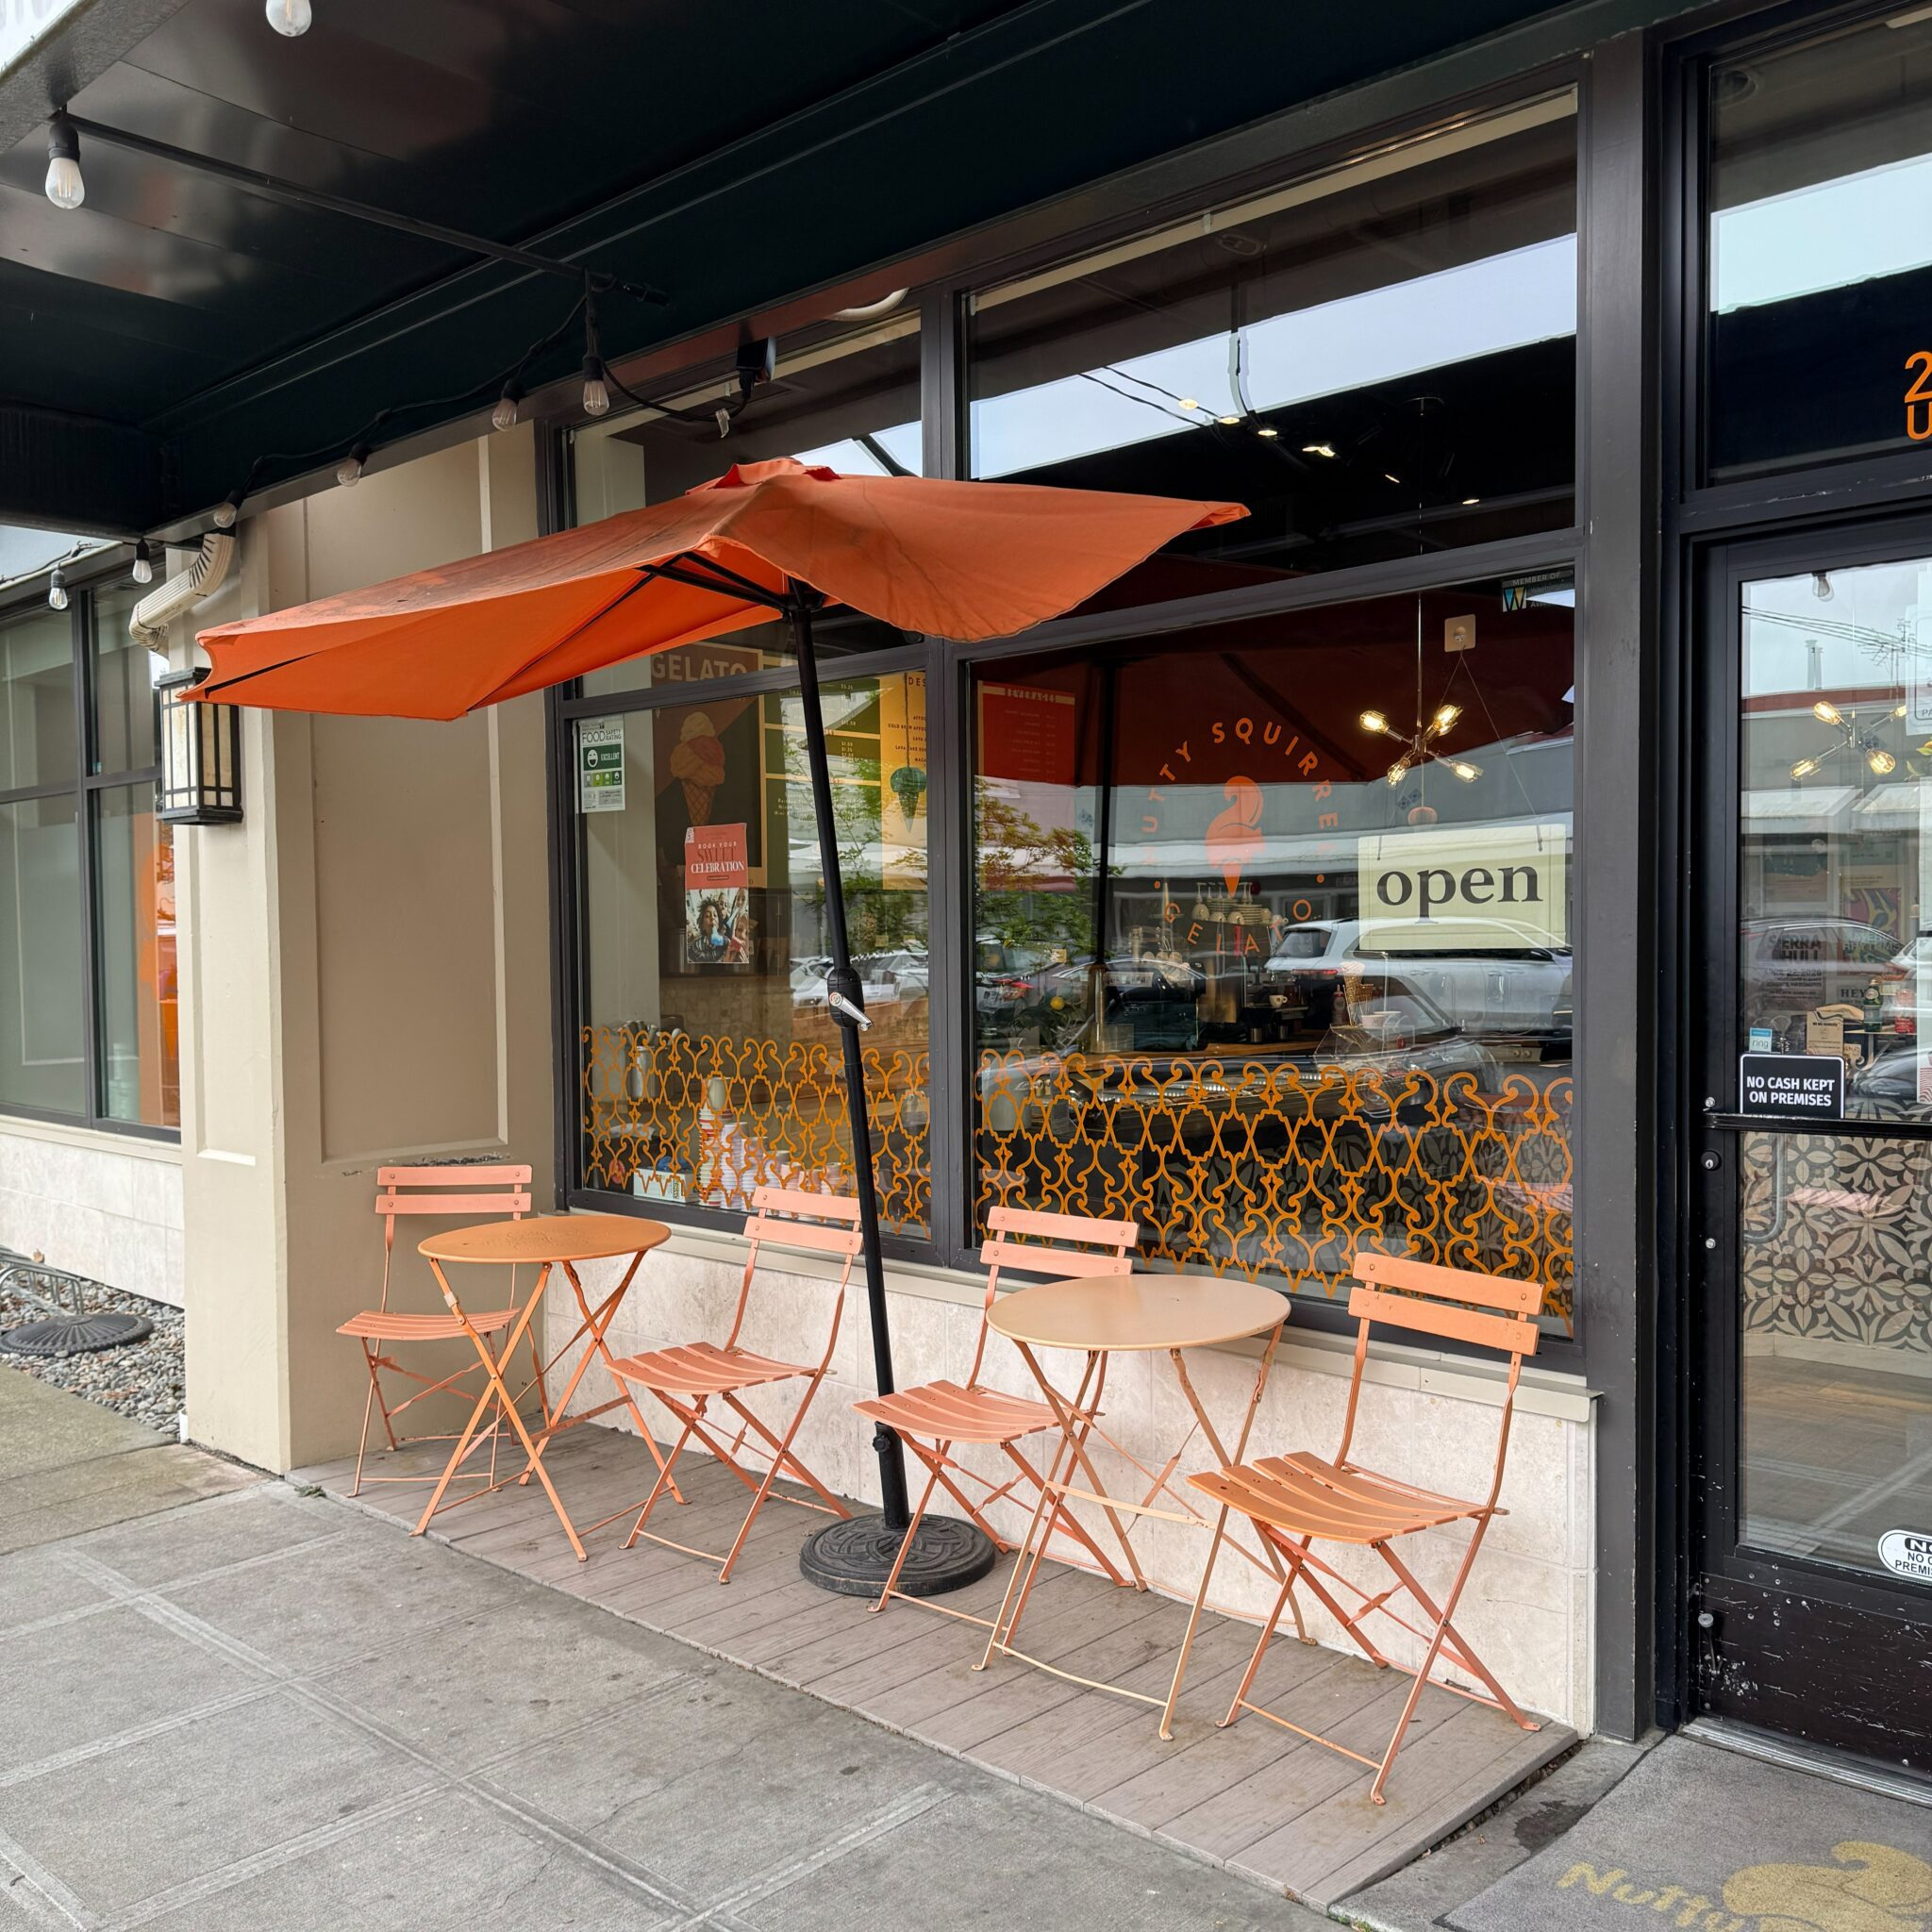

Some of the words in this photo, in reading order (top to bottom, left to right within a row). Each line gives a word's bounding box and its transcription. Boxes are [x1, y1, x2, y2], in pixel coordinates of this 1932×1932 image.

[1512, 573, 1547, 587] MEMBER
[1550, 571, 1561, 580] OF
[582, 731, 606, 743] FOOD
[691, 859, 745, 874] CELEBRATION
[1376, 865, 1544, 924] open
[1164, 899, 1312, 956] GELATO
[1752, 1039, 1769, 1049] ring
[1746, 1075, 1765, 1089] NO
[1767, 1076, 1800, 1091] CASH
[1803, 1078, 1836, 1091] KEPT
[1749, 1091, 1768, 1104] ON
[1770, 1091, 1832, 1108] PREMISES
[1907, 1551, 1924, 1563] NO
[1894, 1559, 1932, 1576] PREMI
